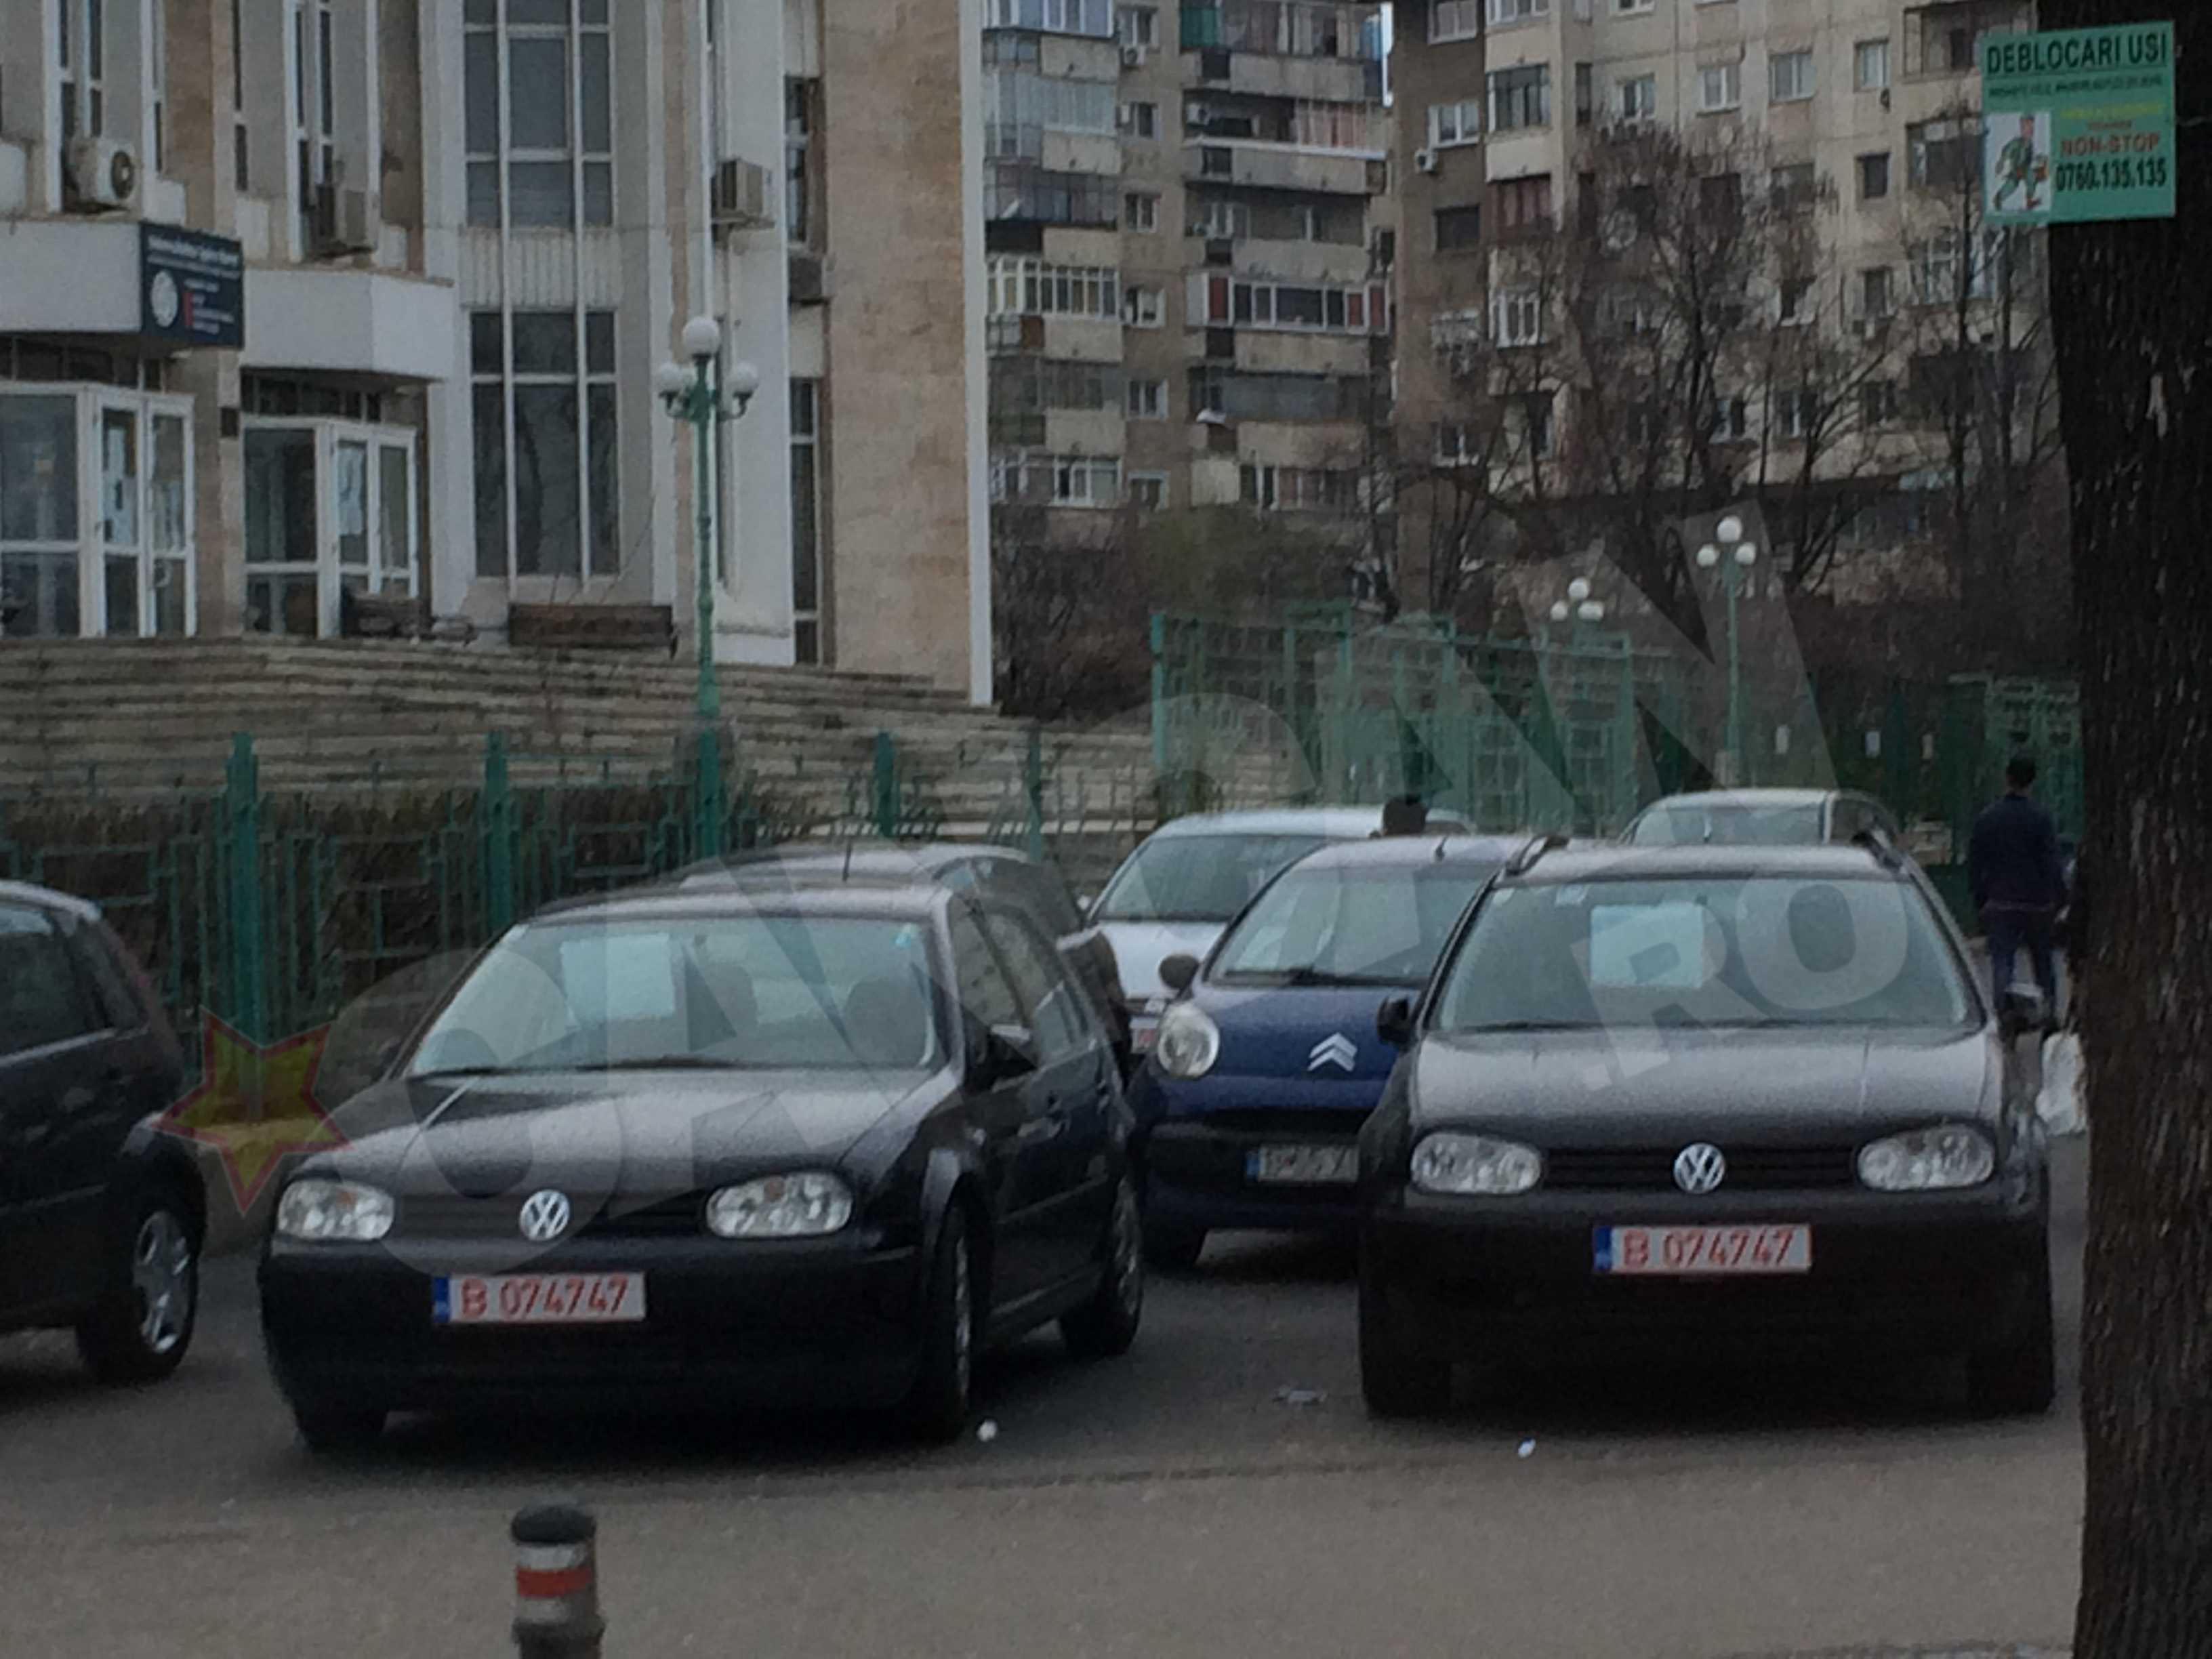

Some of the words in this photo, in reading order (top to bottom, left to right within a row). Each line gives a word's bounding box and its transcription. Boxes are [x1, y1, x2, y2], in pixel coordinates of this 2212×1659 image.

[1986, 35, 2121, 75] DEBLOCARI
[2127, 33, 2167, 65] USI
[2060, 131, 2160, 157] NON-STOP
